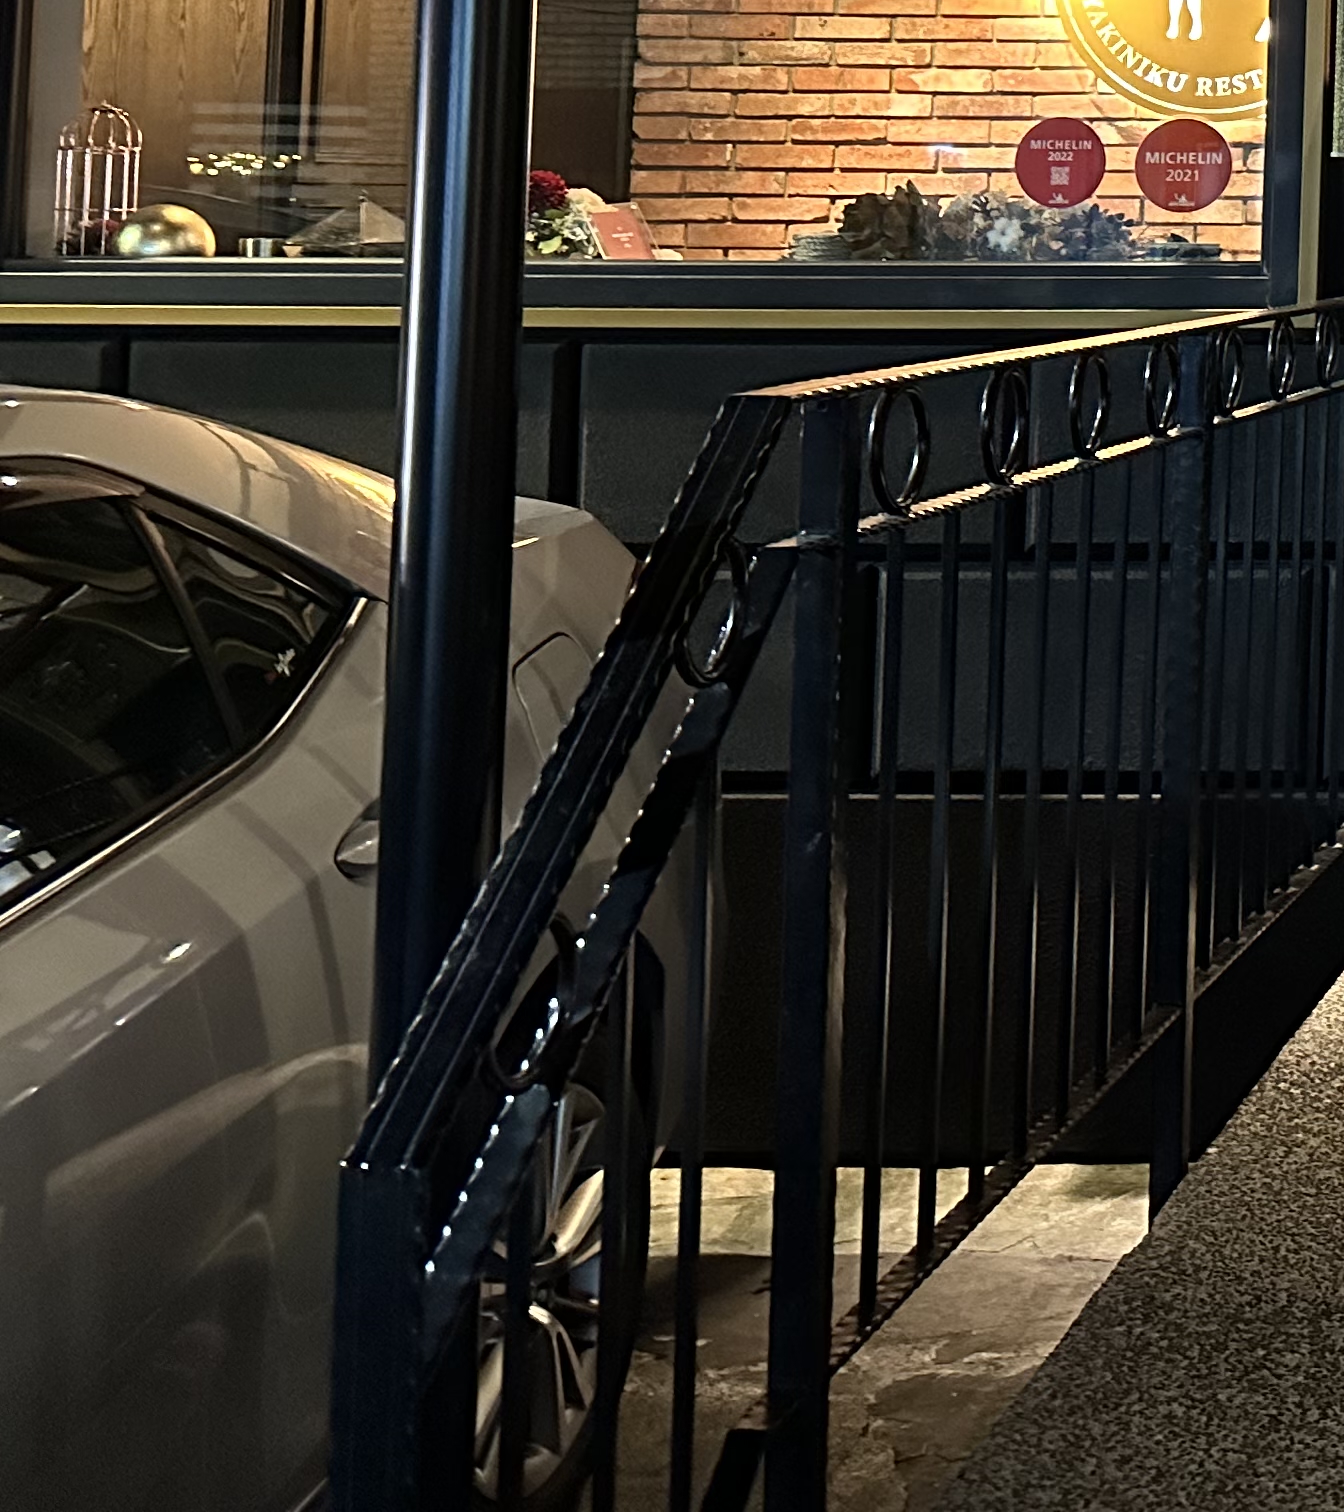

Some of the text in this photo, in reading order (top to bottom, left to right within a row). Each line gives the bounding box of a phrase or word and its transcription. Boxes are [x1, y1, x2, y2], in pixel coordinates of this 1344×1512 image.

[1030, 137, 1093, 152] MICHELIN
[1047, 151, 1074, 162] 2022
[1144, 151, 1224, 166] MICHELIN
[1165, 168, 1200, 182] 2021
